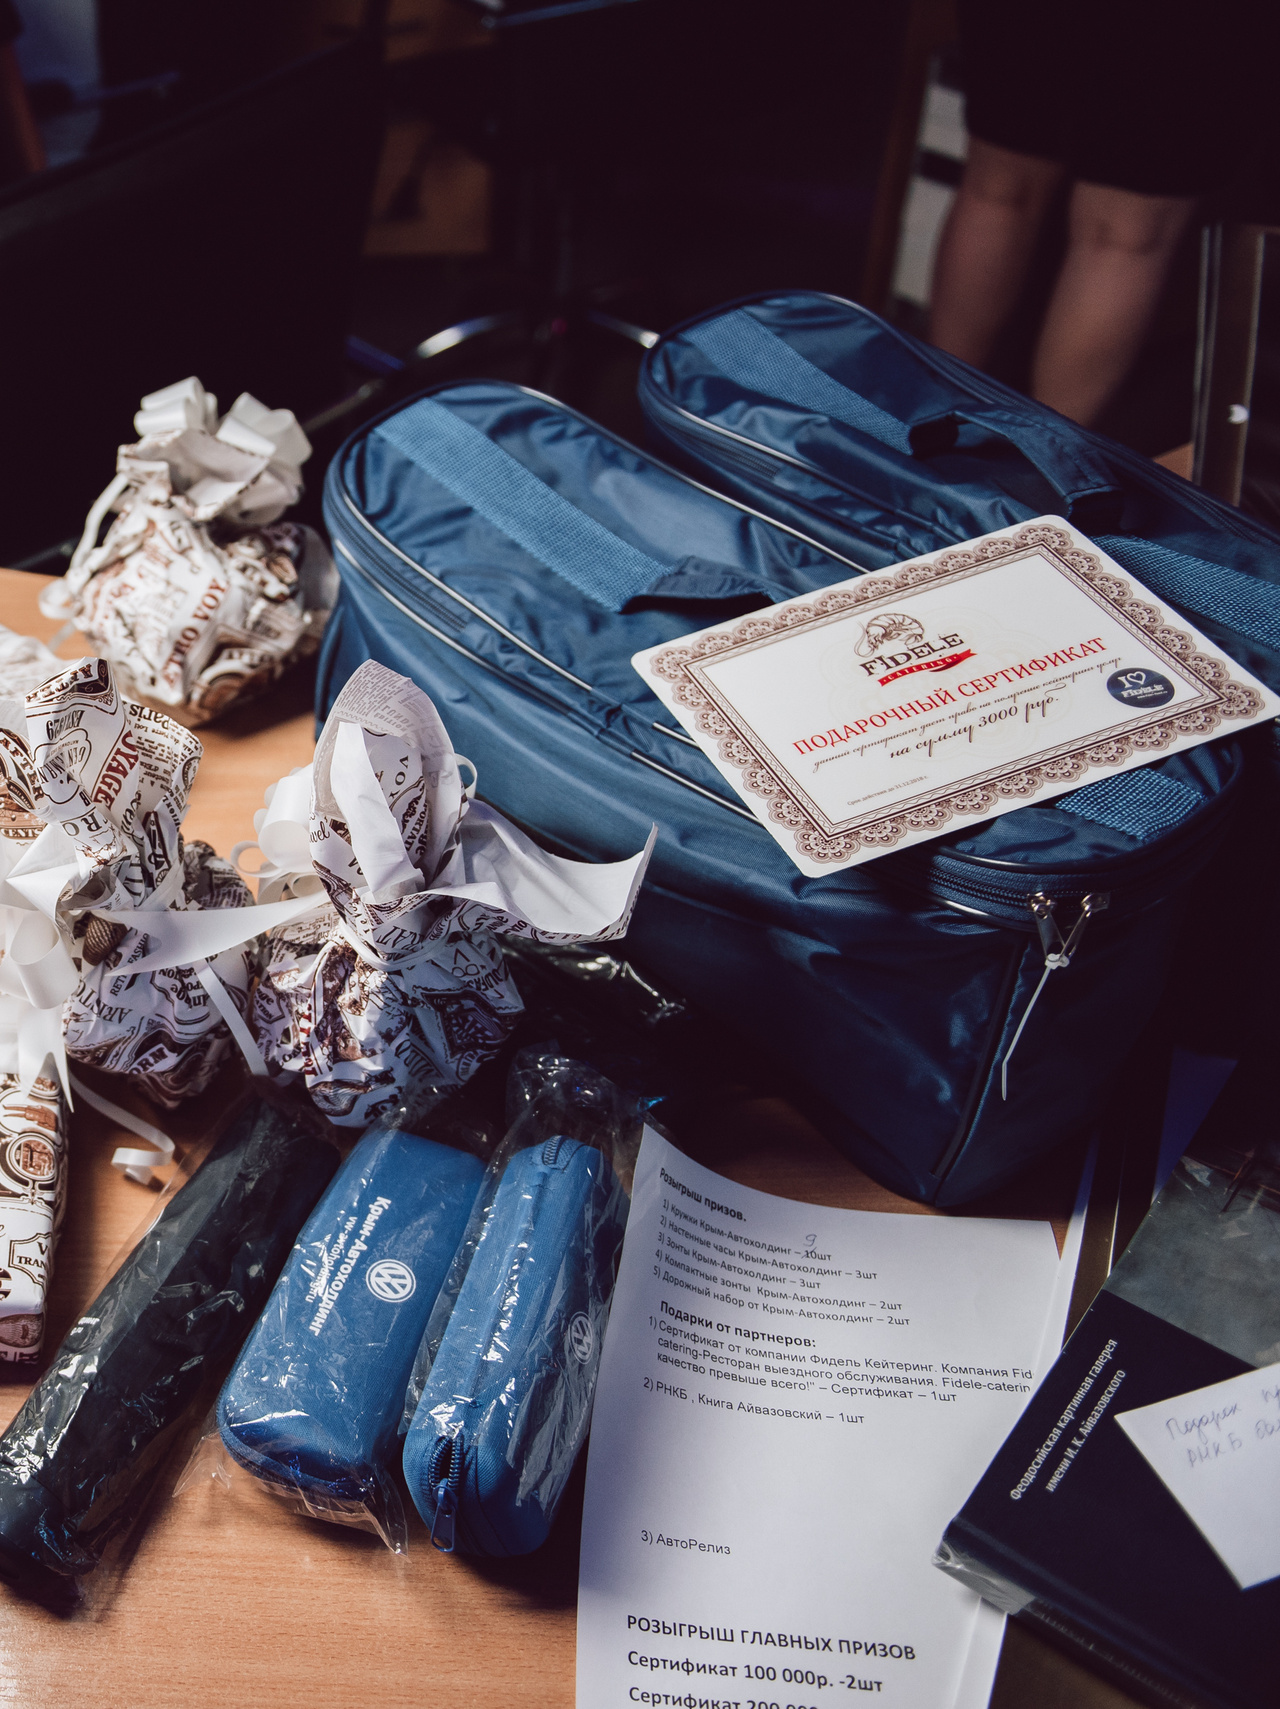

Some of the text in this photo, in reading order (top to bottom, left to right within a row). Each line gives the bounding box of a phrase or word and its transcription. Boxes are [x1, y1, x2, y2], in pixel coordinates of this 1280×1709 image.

[859, 633, 965, 677] FIDELE
[886, 656, 952, 681] CATERING
[792, 637, 1108, 755] ПОДАРОЧНЫЙ СЕРТИФИКАТ
[853, 727, 918, 756] сертификат
[948, 702, 977, 724] право
[994, 684, 1041, 704] получение
[890, 682, 1067, 759] на сумму 3000 руб.
[660, 1167, 747, 1222] Розыгрыш призов.
[669, 1219, 711, 1249] Настенные
[713, 1241, 736, 1258] часы
[738, 1250, 842, 1277] Крым-Автохолдинг
[855, 1269, 878, 1280] 3шт
[670, 1203, 698, 1225] Кружки
[700, 1220, 792, 1256] Крым-Автохолдинг
[309, 1196, 392, 1337] Крым-Автохолдинг
[664, 1252, 718, 1283] Компактные
[720, 1278, 751, 1293] зонты
[756, 1286, 866, 1308] Крым-Автохолдинг
[879, 1300, 902, 1311] 2шт
[666, 1236, 691, 1256] Зонты
[692, 1248, 787, 1285] Крым-Автохолдинг
[799, 1278, 821, 1289] 3шт
[660, 1300, 816, 1348] Подарки от партнеров:
[662, 1270, 711, 1298] Дорожный
[713, 1292, 745, 1308] набор
[747, 1301, 759, 1311] от
[762, 1303, 873, 1324] Крым-Автохолдинг
[887, 1315, 910, 1326] 2шт
[657, 1336, 760, 1371] catering-Ресторан
[764, 1364, 833, 1380] выездного
[837, 1371, 938, 1388] обслуживания.
[658, 1319, 724, 1350] Сертификат
[728, 1343, 741, 1354] от
[745, 1346, 806, 1363] компании
[810, 1354, 861, 1368] Фидель
[864, 1358, 938, 1374] Кейтеринг.
[941, 1363, 1008, 1378] Компания
[1012, 1368, 1035, 1380] Fid
[643, 1377, 865, 1424] 2) РНКБ Книга Айвазовский 1шт
[657, 1352, 706, 1374] качество
[709, 1367, 767, 1386] превыше
[831, 1383, 914, 1400] Сертификат
[931, 1391, 957, 1402] 1шт
[1010, 1338, 1118, 1500] Феодосийская картинная галерея
[1046, 1457, 1072, 1493] имени
[1076, 1369, 1127, 1440] Айвазовского
[641, 1529, 731, 1555] 3) АвтоРелиз
[627, 1614, 916, 1661] РОЗЫГРЫШ ГЛАВНЫХ ПРИЗОВ
[628, 1651, 738, 1678] Сертификат
[744, 1664, 777, 1682] 100
[782, 1668, 833, 1690] 000р.
[629, 1687, 741, 1709] Сертификат
